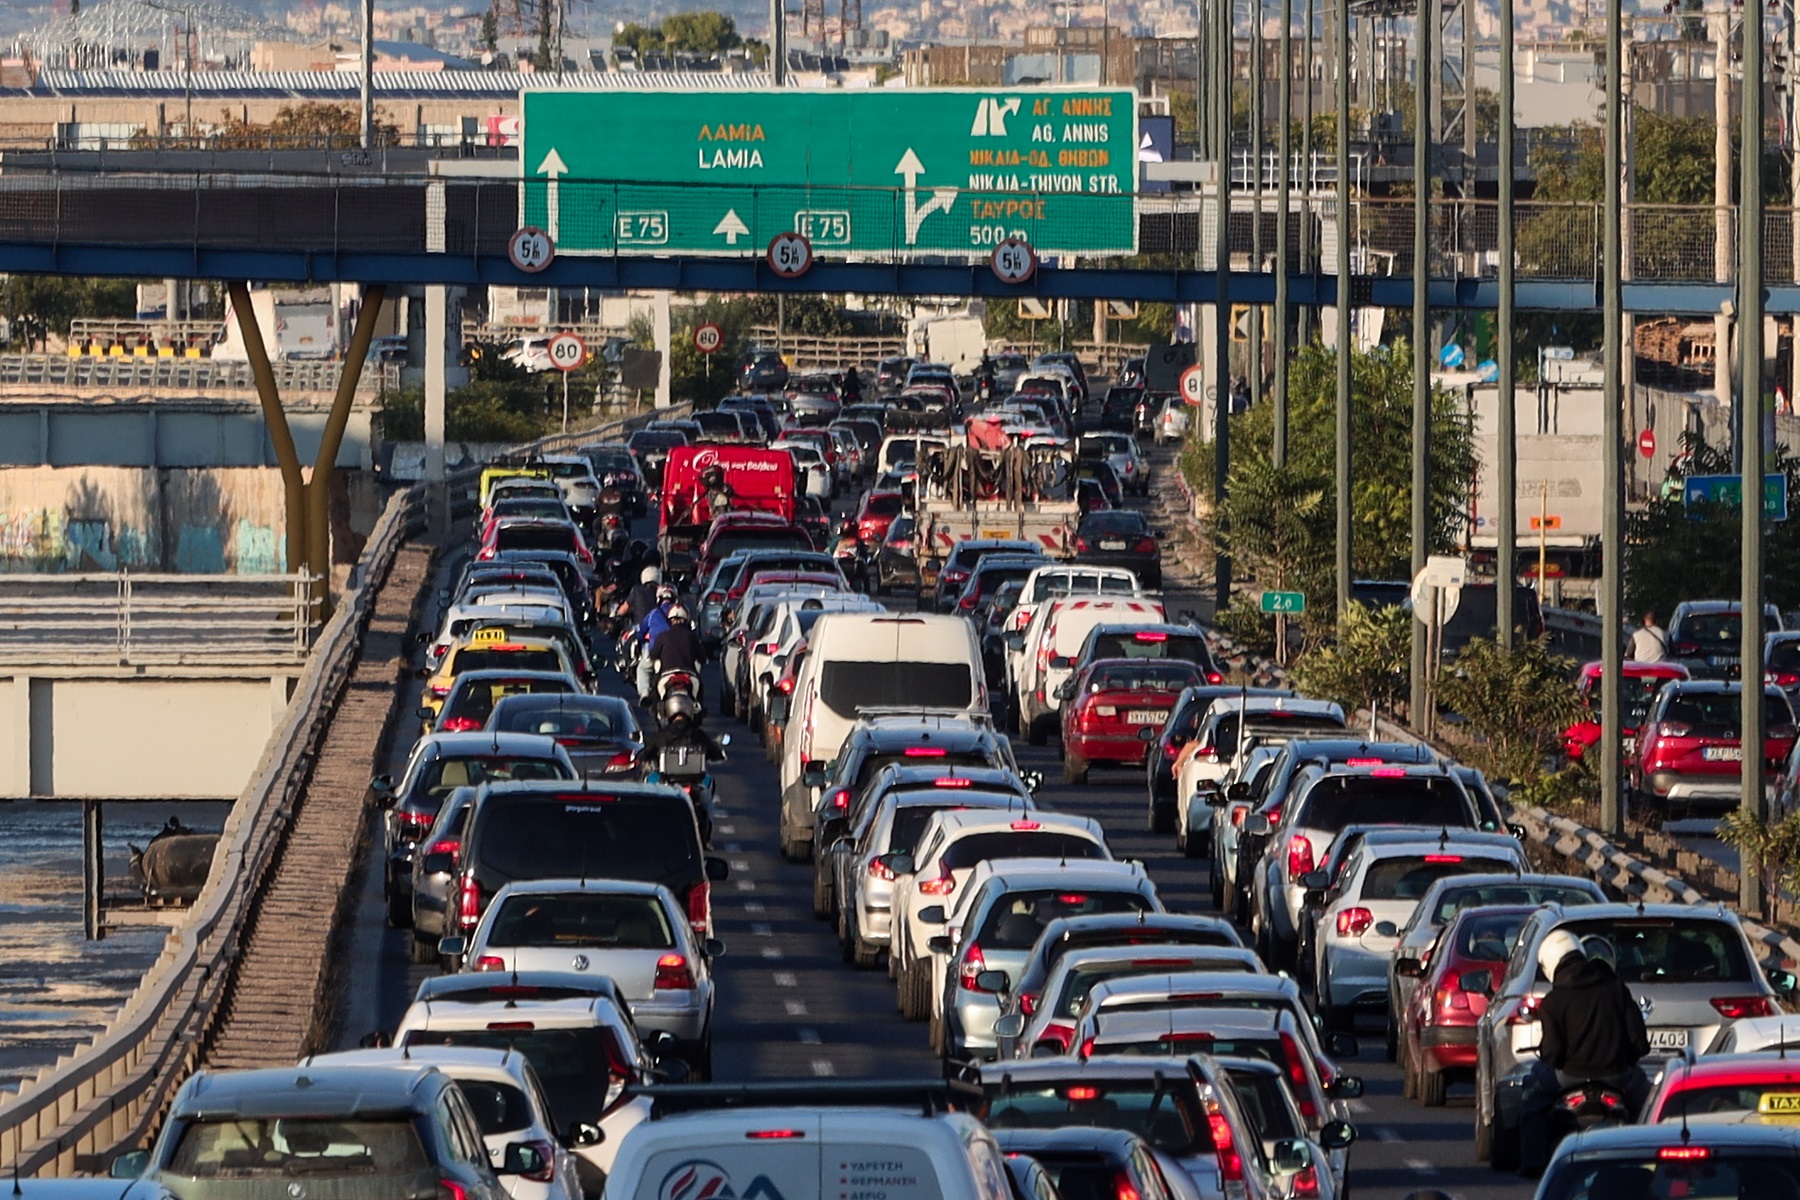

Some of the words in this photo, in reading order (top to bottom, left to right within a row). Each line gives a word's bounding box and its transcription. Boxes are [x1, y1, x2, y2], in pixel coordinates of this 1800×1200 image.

[1062, 98, 1112, 116] ΑΝΝΗΣ
[698, 124, 765, 141] ΛΑΜΙΑ
[1062, 123, 1109, 142] ANNIS
[699, 148, 763, 168] LAMIA
[968, 173, 1083, 193] NIKAIA-THIVON
[1088, 175, 1123, 194] STR.
[620, 217, 633, 238] E
[639, 217, 663, 238] 75
[802, 217, 814, 238] E
[820, 217, 844, 238] 75
[969, 225, 1006, 245] 500
[522, 240, 531, 258] 5
[780, 246, 790, 265] 5
[1003, 252, 1012, 270] 5
[555, 344, 577, 359] 80
